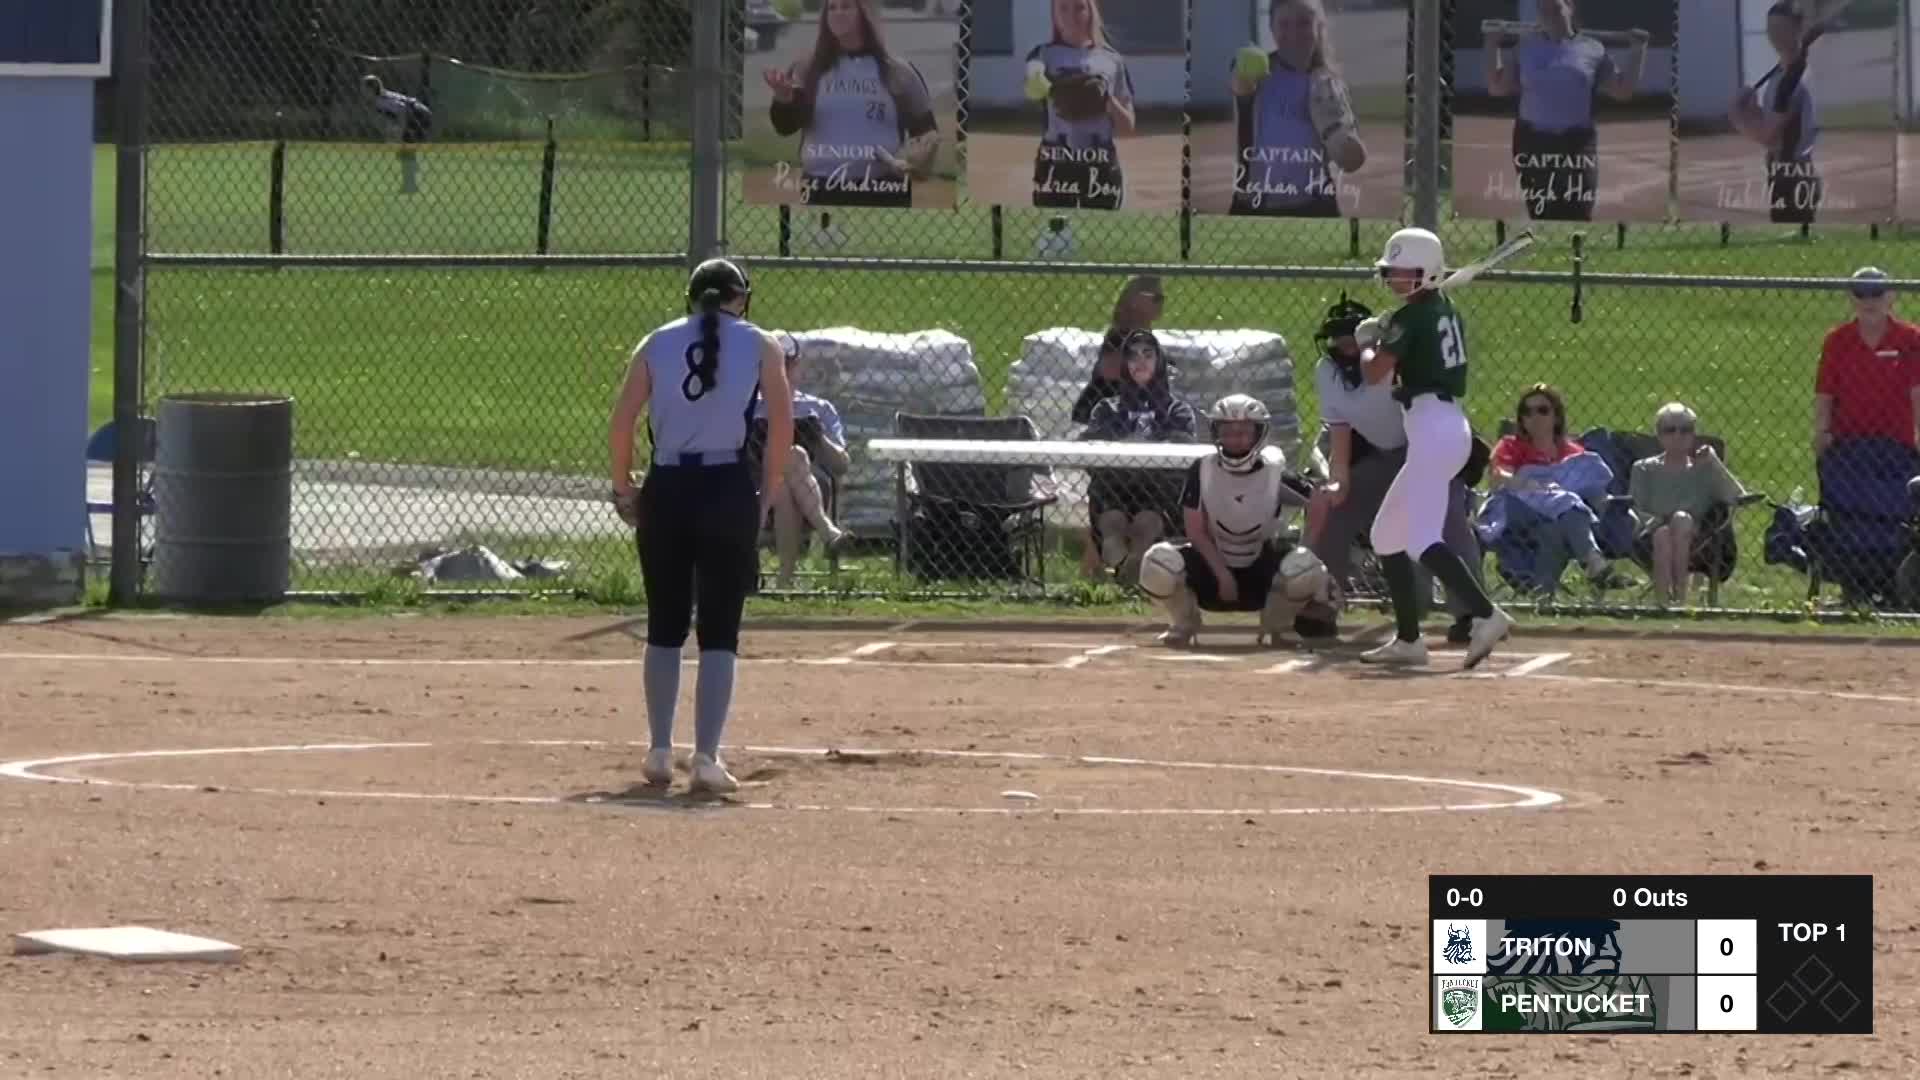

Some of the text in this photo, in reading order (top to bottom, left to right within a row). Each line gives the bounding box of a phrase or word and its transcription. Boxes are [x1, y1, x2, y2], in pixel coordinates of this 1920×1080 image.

[806, 144, 875, 160] SENIOR
[1040, 146, 1109, 162] SENIOR
[1242, 147, 1325, 162] CAPTAIN
[1513, 152, 1597, 169] CAPTAIN
[1437, 314, 1467, 369] 21
[682, 339, 720, 402] 8
